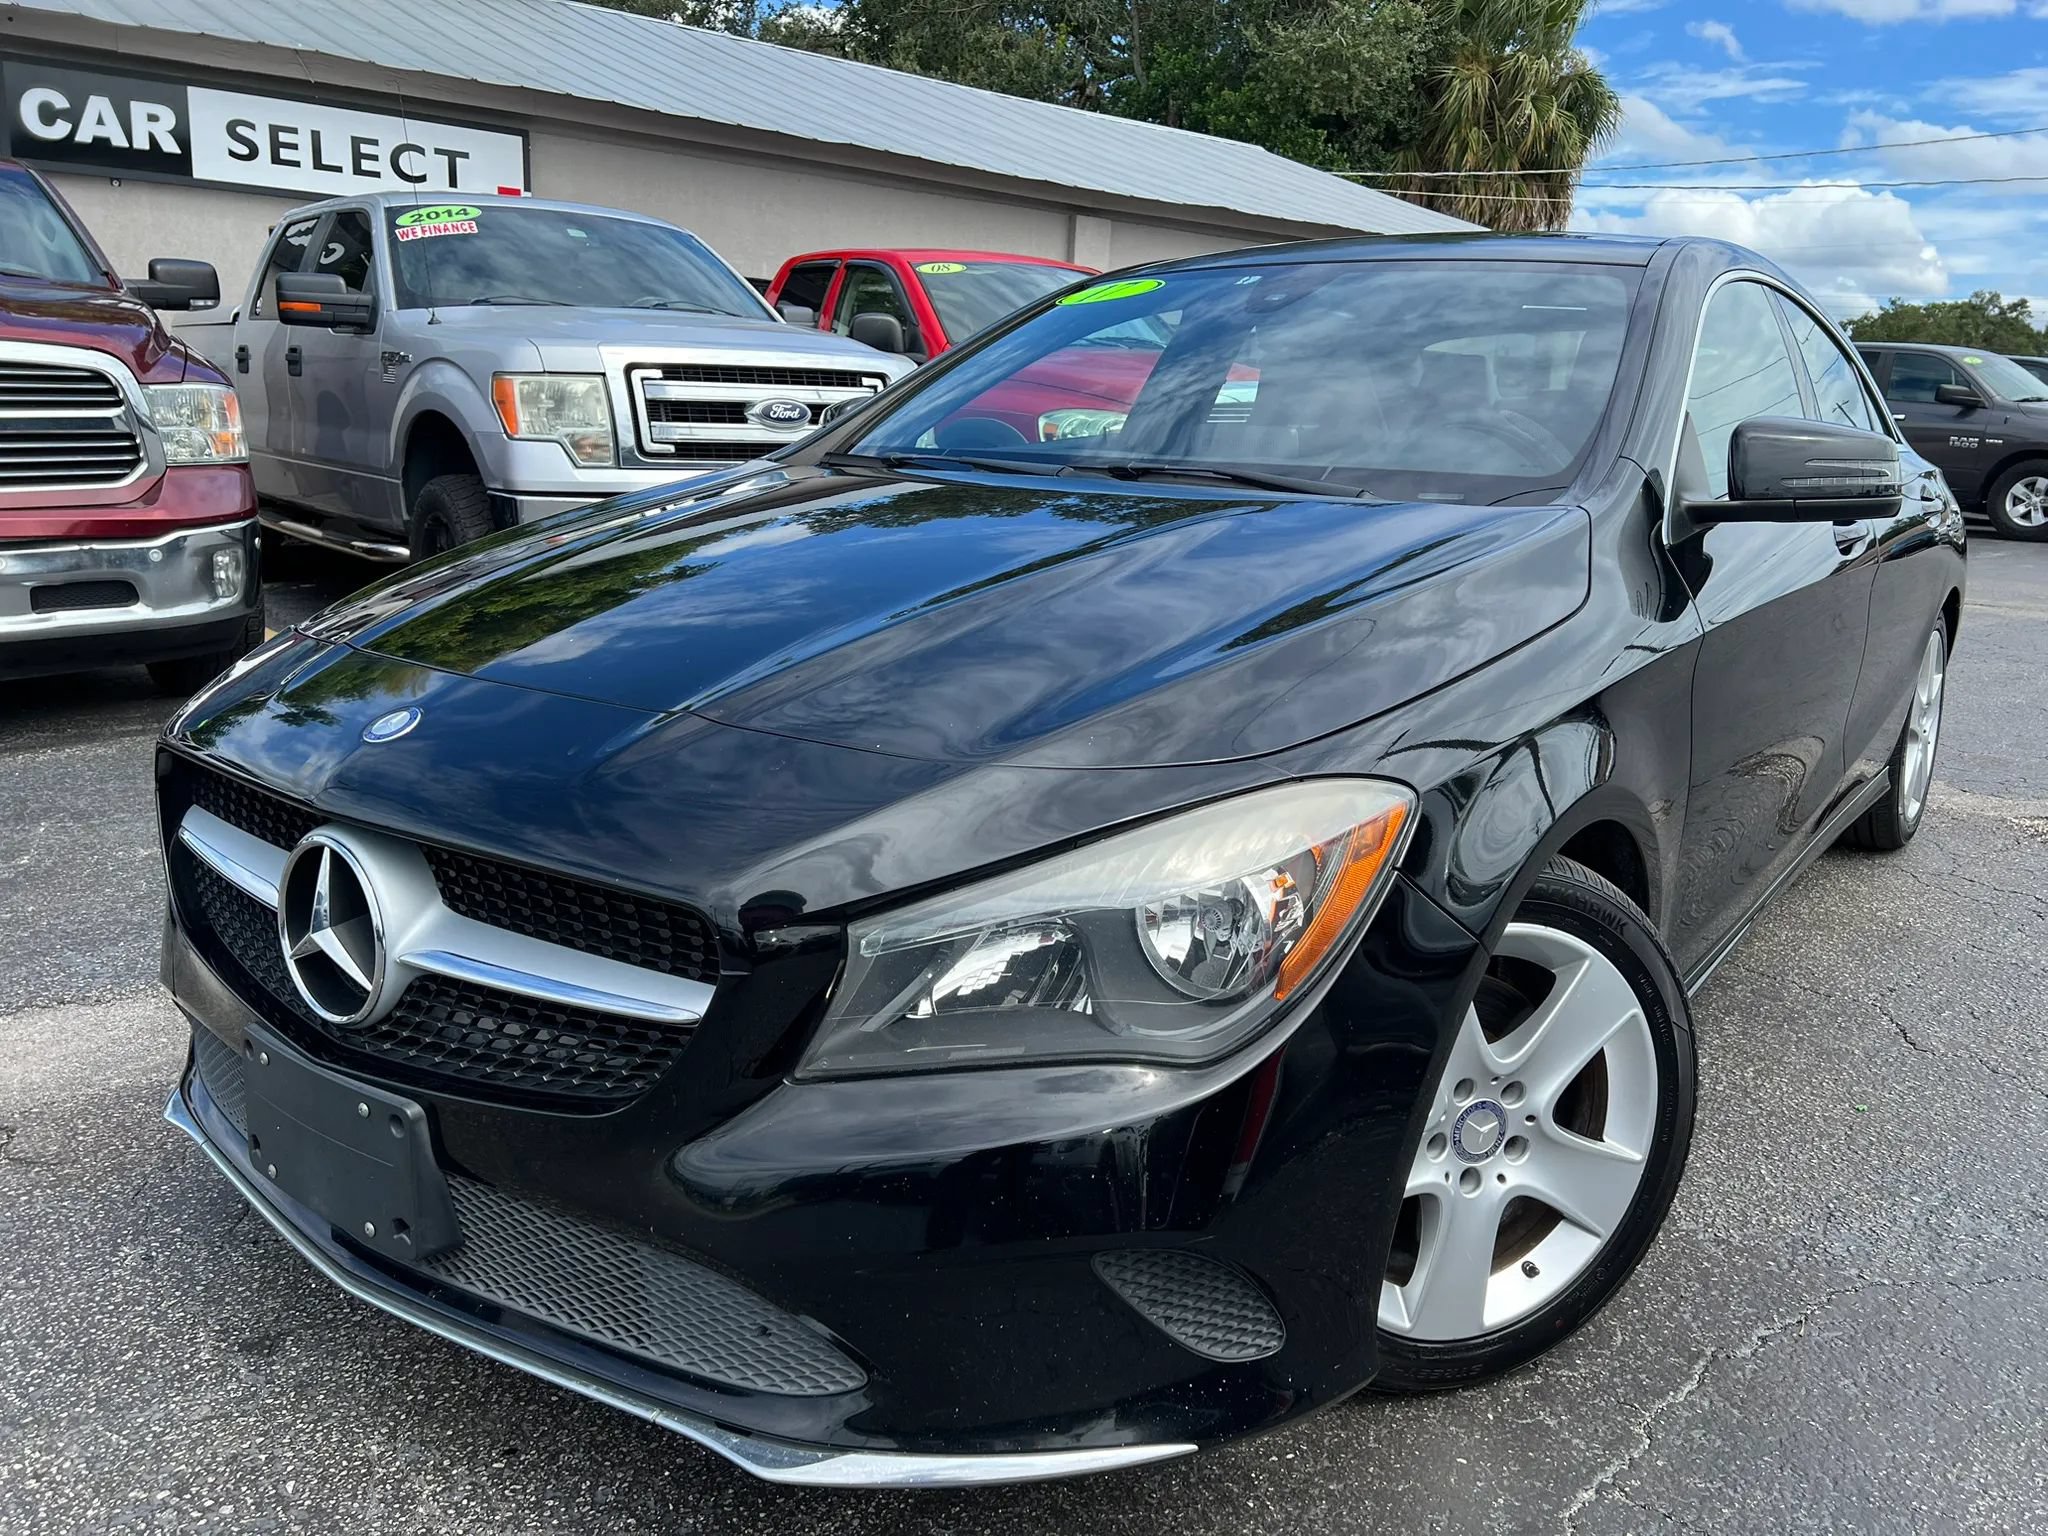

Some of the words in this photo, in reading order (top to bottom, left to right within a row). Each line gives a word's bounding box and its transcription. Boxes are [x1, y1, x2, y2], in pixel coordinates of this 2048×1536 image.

[19, 87, 183, 155] CAR
[225, 118, 471, 189] SELECT
[409, 207, 471, 224] 2014
[398, 226, 419, 240] WE
[420, 221, 476, 236] FINANCE
[769, 403, 801, 419] Ford
